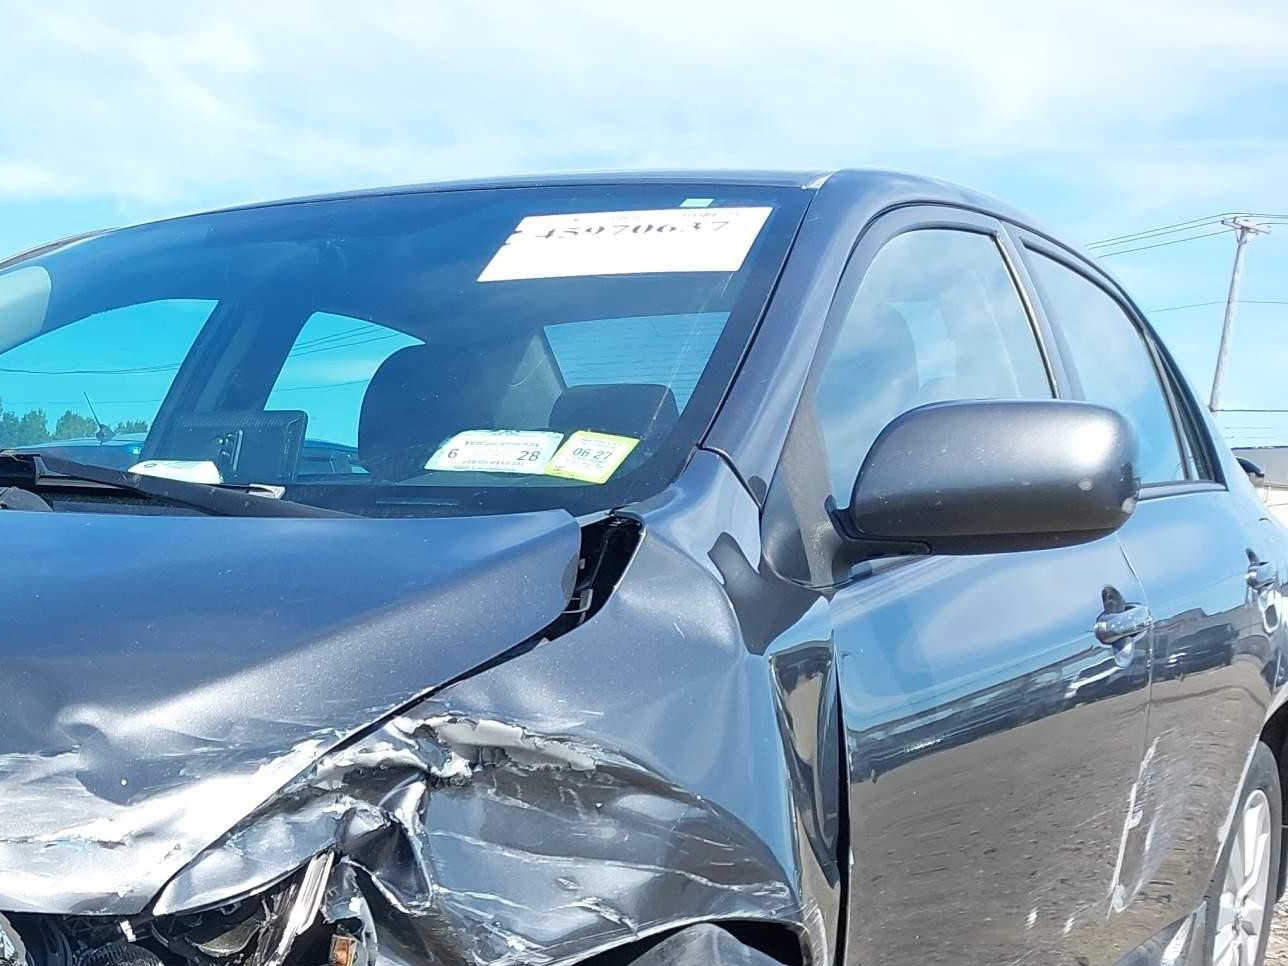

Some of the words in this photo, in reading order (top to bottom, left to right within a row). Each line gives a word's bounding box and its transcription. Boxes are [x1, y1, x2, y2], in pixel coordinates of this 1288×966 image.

[447, 448, 459, 459] 6
[516, 450, 541, 461] 28
[572, 447, 592, 458] 06
[593, 450, 613, 461] 27
